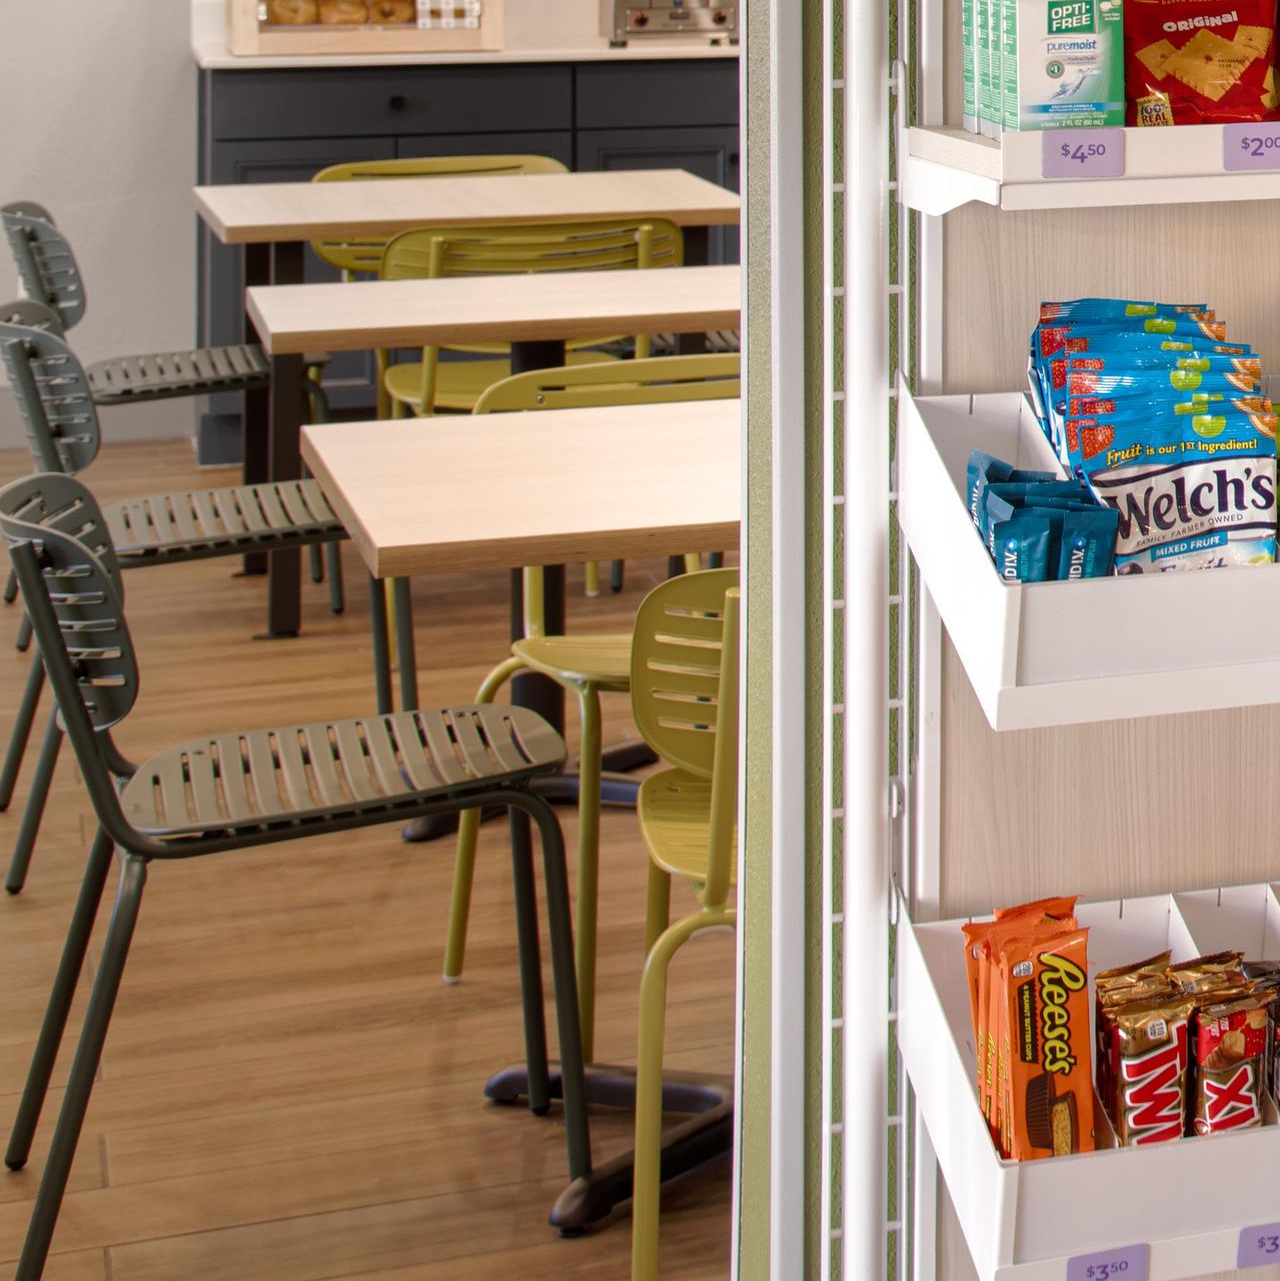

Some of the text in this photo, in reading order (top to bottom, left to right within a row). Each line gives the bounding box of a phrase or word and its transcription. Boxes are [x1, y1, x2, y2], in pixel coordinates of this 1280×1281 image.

[1051, 1, 1091, 19] OPTI-
[1051, 13, 1093, 33] FREE
[1046, 38, 1096, 54] puremoist
[1101, 467, 1276, 541] Welch's
[1156, 536, 1222, 557] MIXED FRUIT
[1038, 953, 1086, 1075] Reese's
